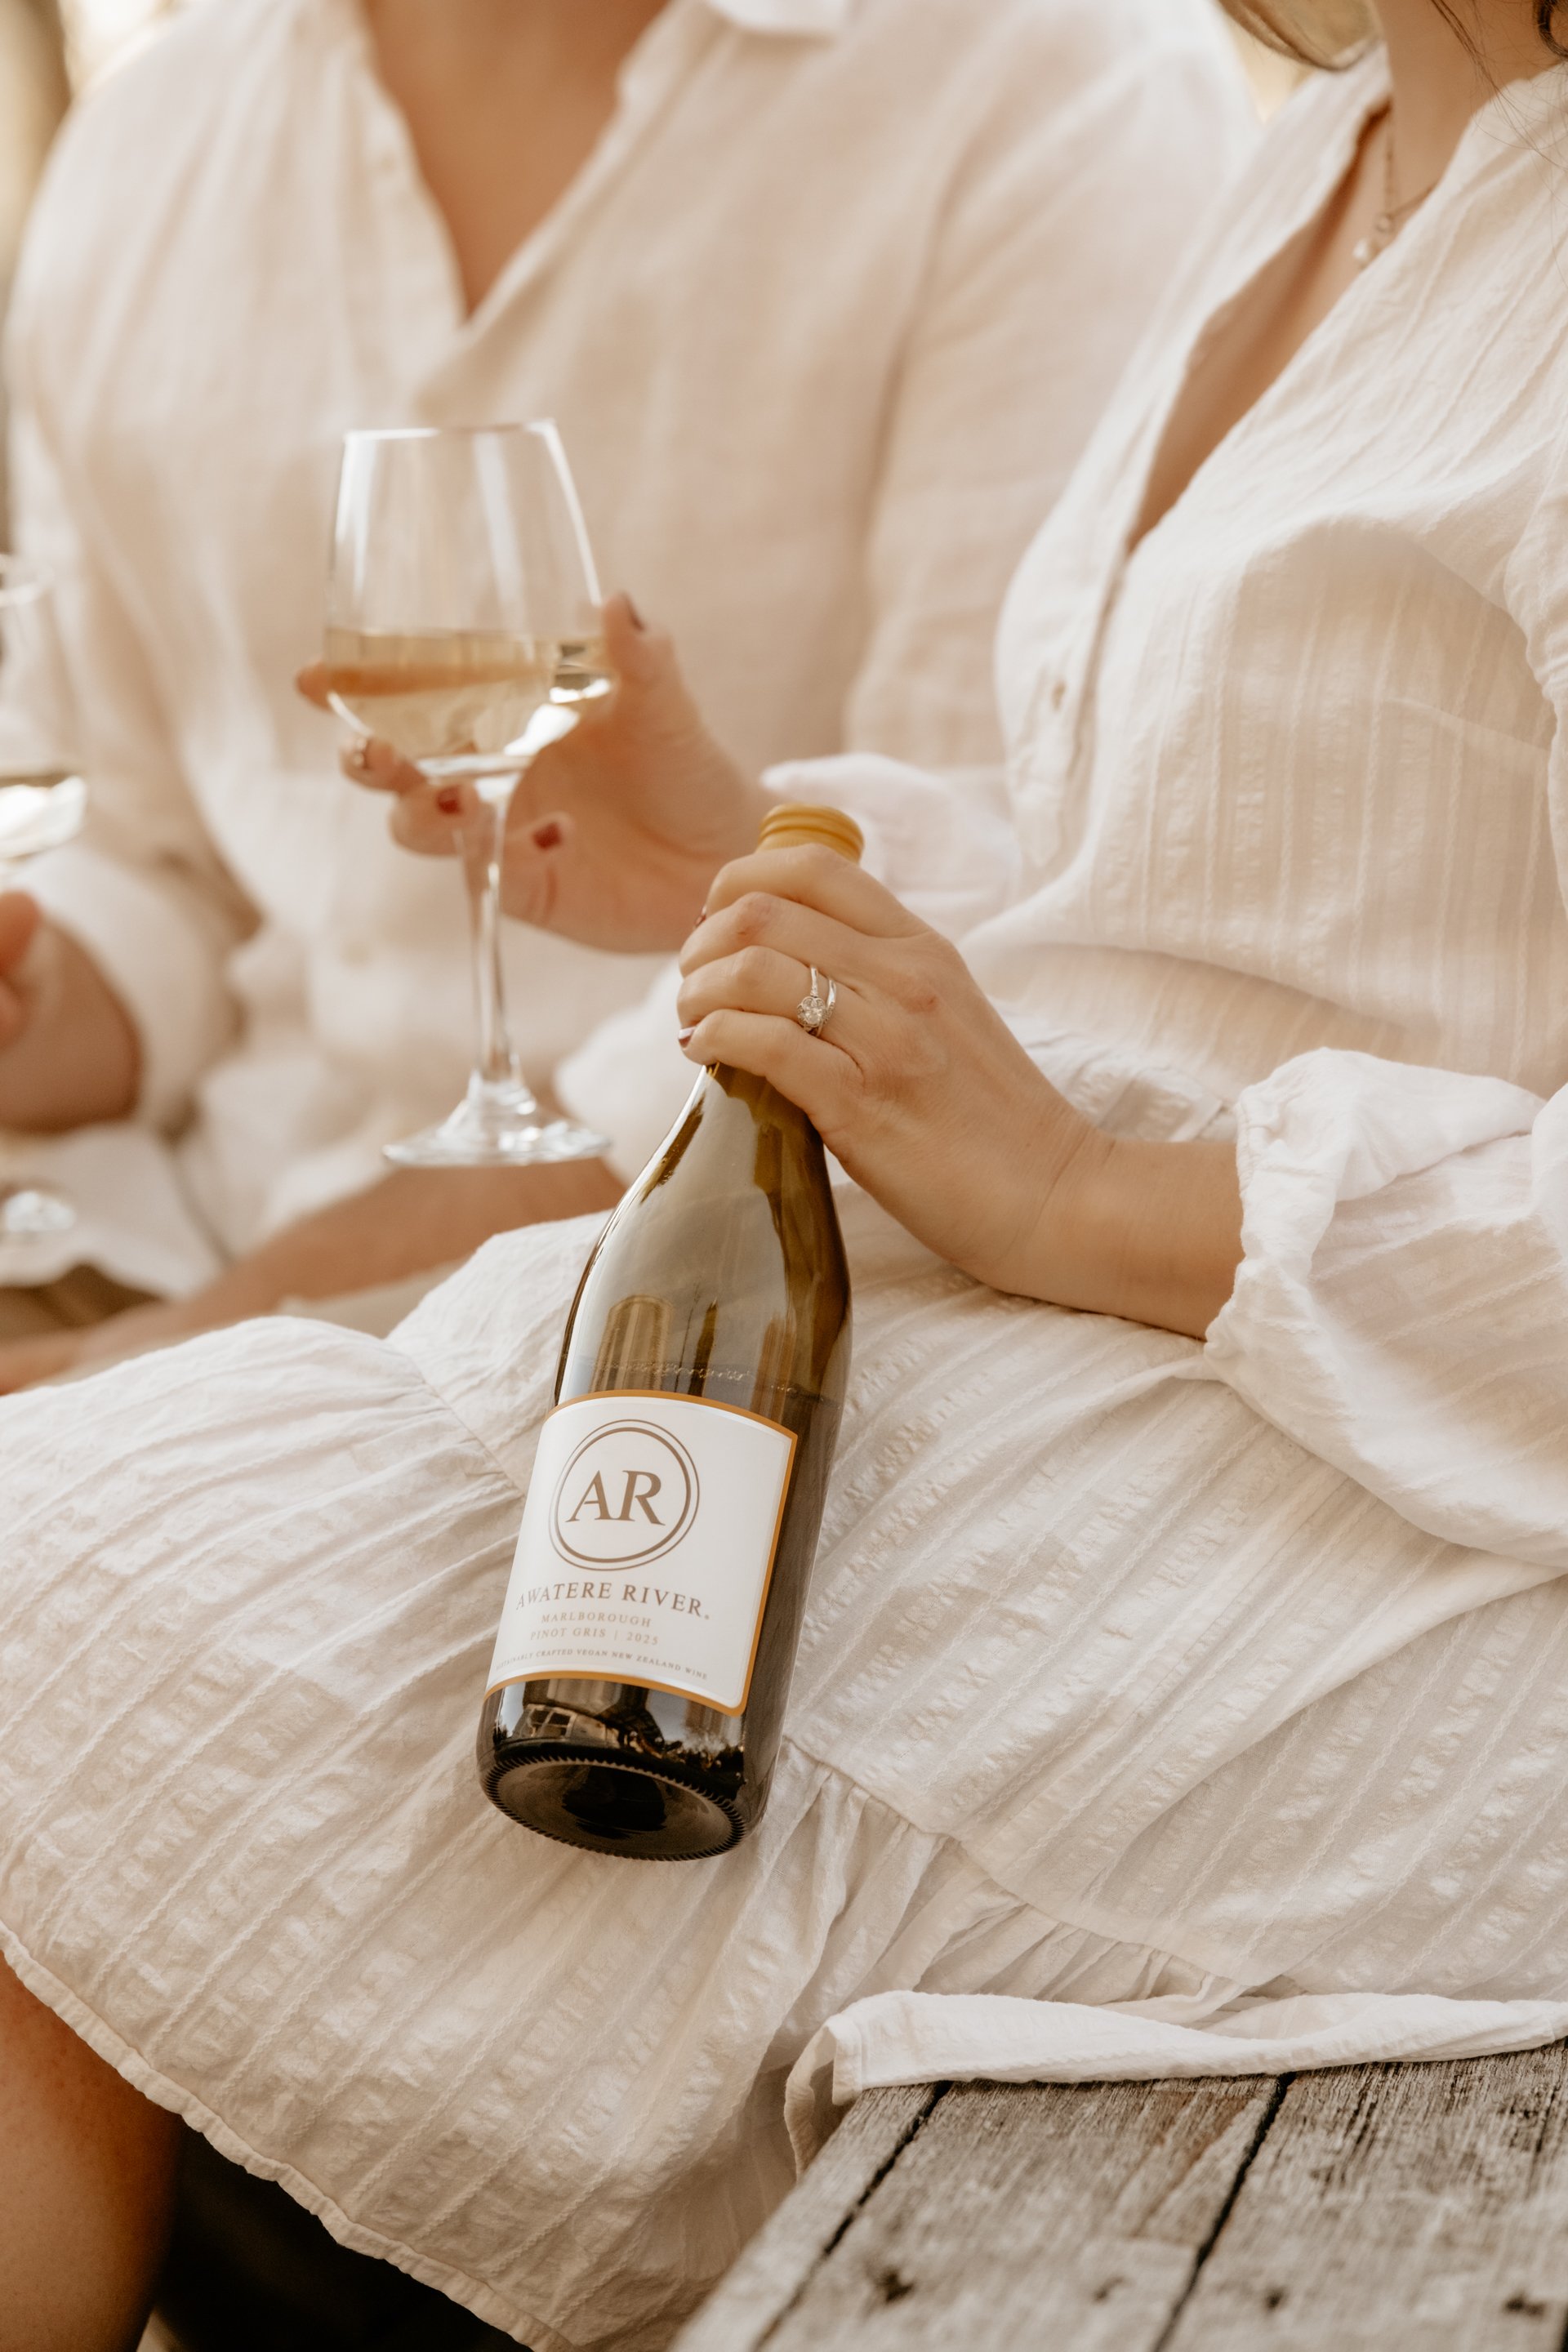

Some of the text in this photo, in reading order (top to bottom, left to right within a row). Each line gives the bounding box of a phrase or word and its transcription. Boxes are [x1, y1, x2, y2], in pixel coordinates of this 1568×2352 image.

[565, 1469, 666, 1526] AR
[517, 1581, 613, 1610] AWATERE
[541, 1611, 652, 1628] MARLBOROUGH
[530, 1627, 660, 1646] PINOT GRIS 2025
[535, 1648, 573, 1658] CRAFTED
[577, 1648, 608, 1657] VEGAN
[612, 1650, 634, 1661] NEW
[636, 1655, 682, 1672] ZEALAND
[685, 1666, 708, 1680] WINE
